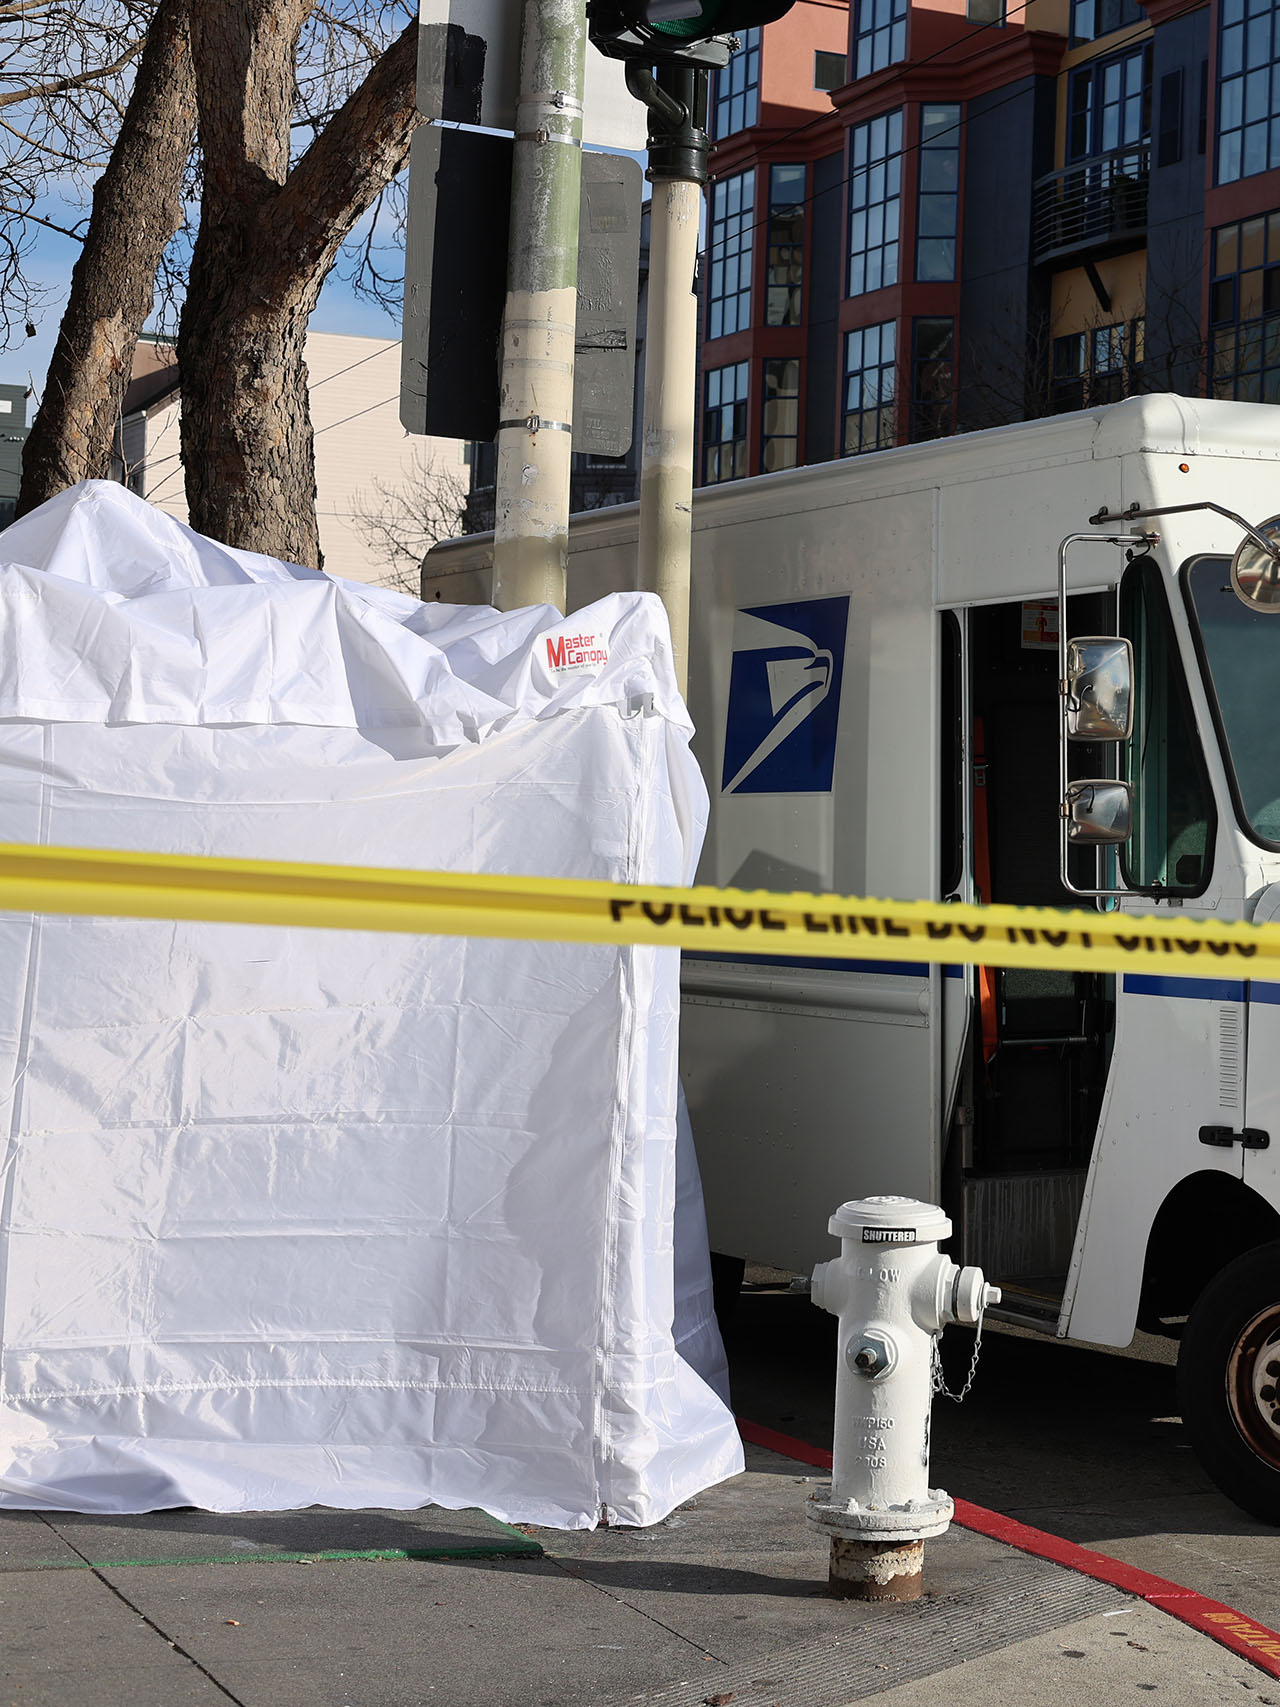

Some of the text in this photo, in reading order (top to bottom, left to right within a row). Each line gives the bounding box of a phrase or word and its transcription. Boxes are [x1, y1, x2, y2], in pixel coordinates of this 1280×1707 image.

[546, 633, 595, 669] Master
[568, 649, 608, 665] Canopy
[863, 1229, 916, 1242] SHUTTERED
